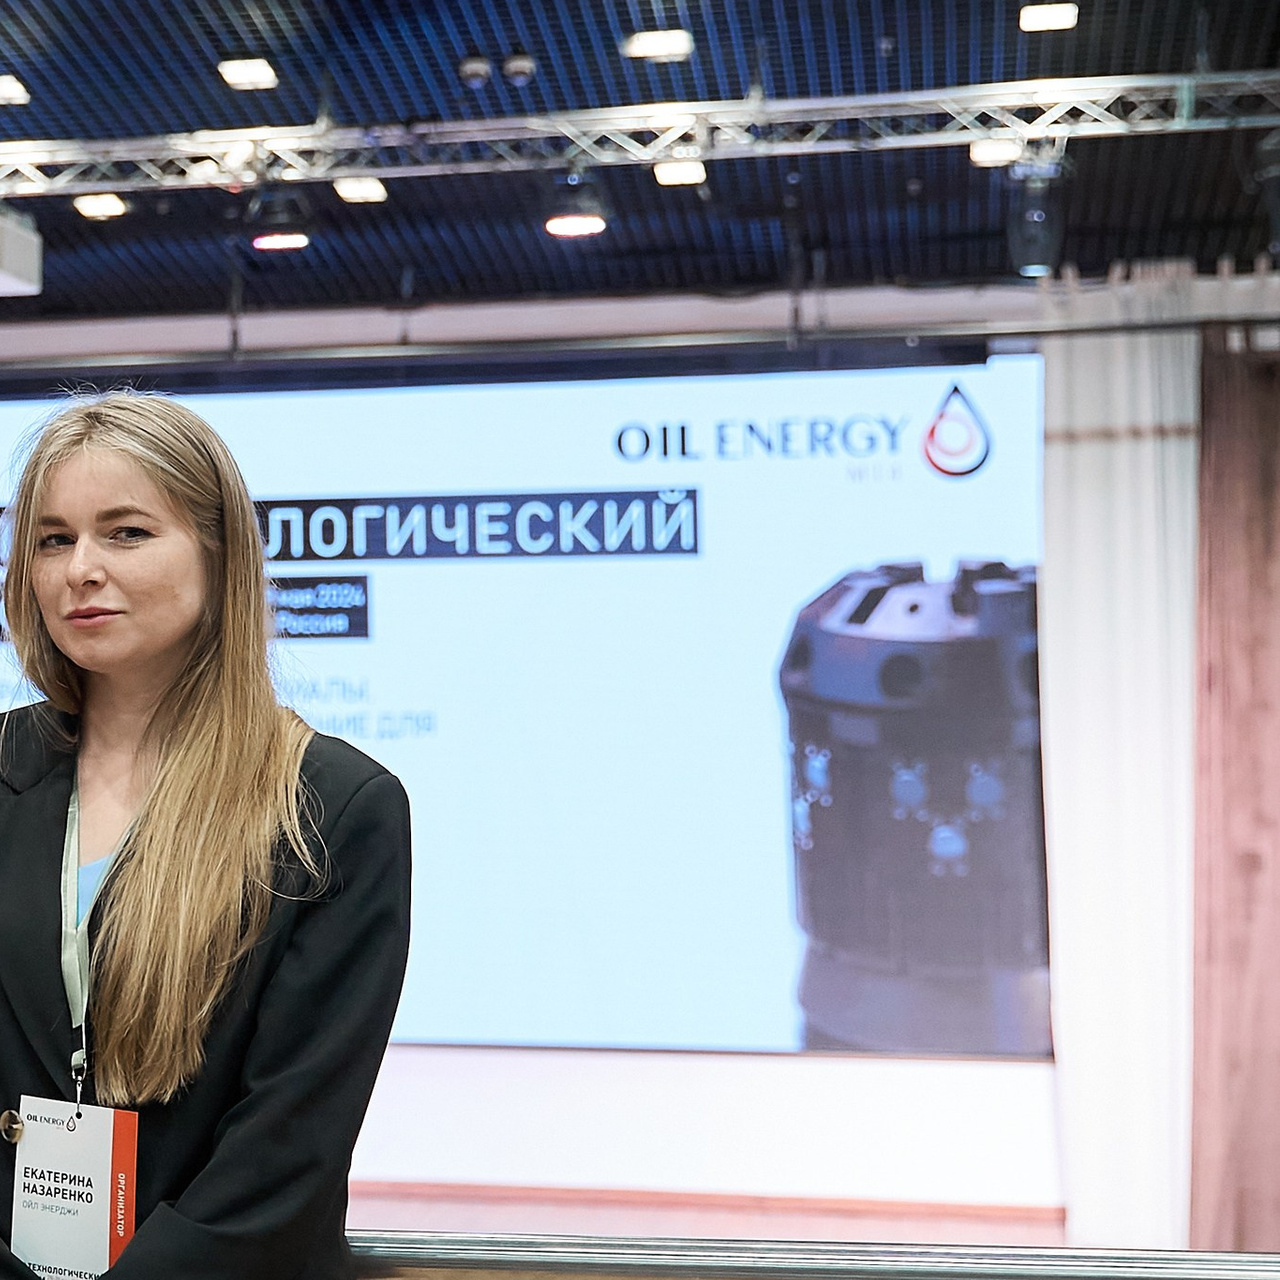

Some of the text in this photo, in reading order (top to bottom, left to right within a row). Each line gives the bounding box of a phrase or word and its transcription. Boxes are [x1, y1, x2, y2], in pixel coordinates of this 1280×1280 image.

[617, 418, 909, 461] OIL ENERGY
[267, 490, 694, 558] ЛОГИЧЕСКИЙ
[26, 1113, 65, 1126] OIL ENERGY
[23, 1166, 94, 1189] ЕКАТЕРИНА
[22, 1181, 94, 1204] НАЗАРЕНКО
[22, 1199, 79, 1217] ОЙЛ ЭНЕРДЖИ
[116, 1173, 126, 1237] ОРГАНИЗАТОР
